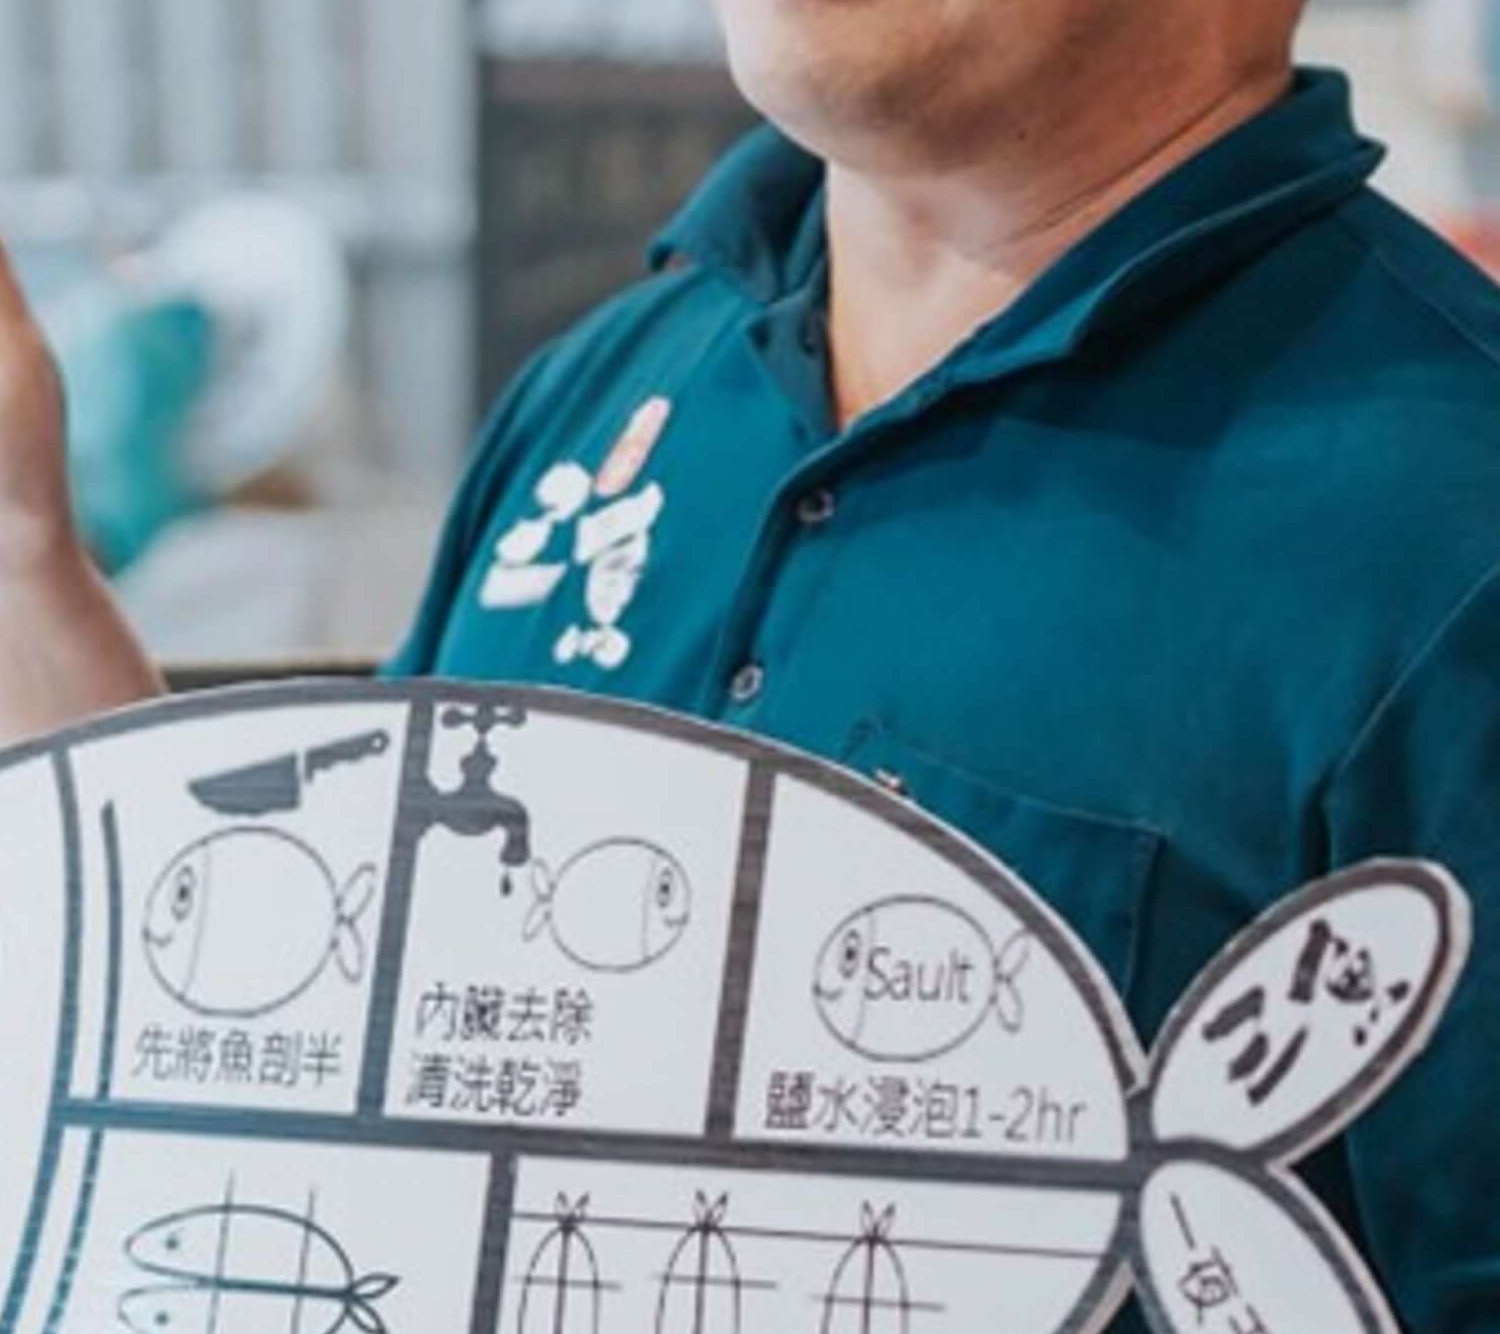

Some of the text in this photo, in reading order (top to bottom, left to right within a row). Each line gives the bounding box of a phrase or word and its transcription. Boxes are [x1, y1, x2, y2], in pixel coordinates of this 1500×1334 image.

[865, 946, 974, 1003] Sault
[416, 981, 594, 1045] 內臟去除
[129, 1023, 343, 1087] 先將魚剖半
[405, 1051, 582, 1117] 清洗乾淨
[763, 1069, 1090, 1143] 鹽水浸泡1-2hr
